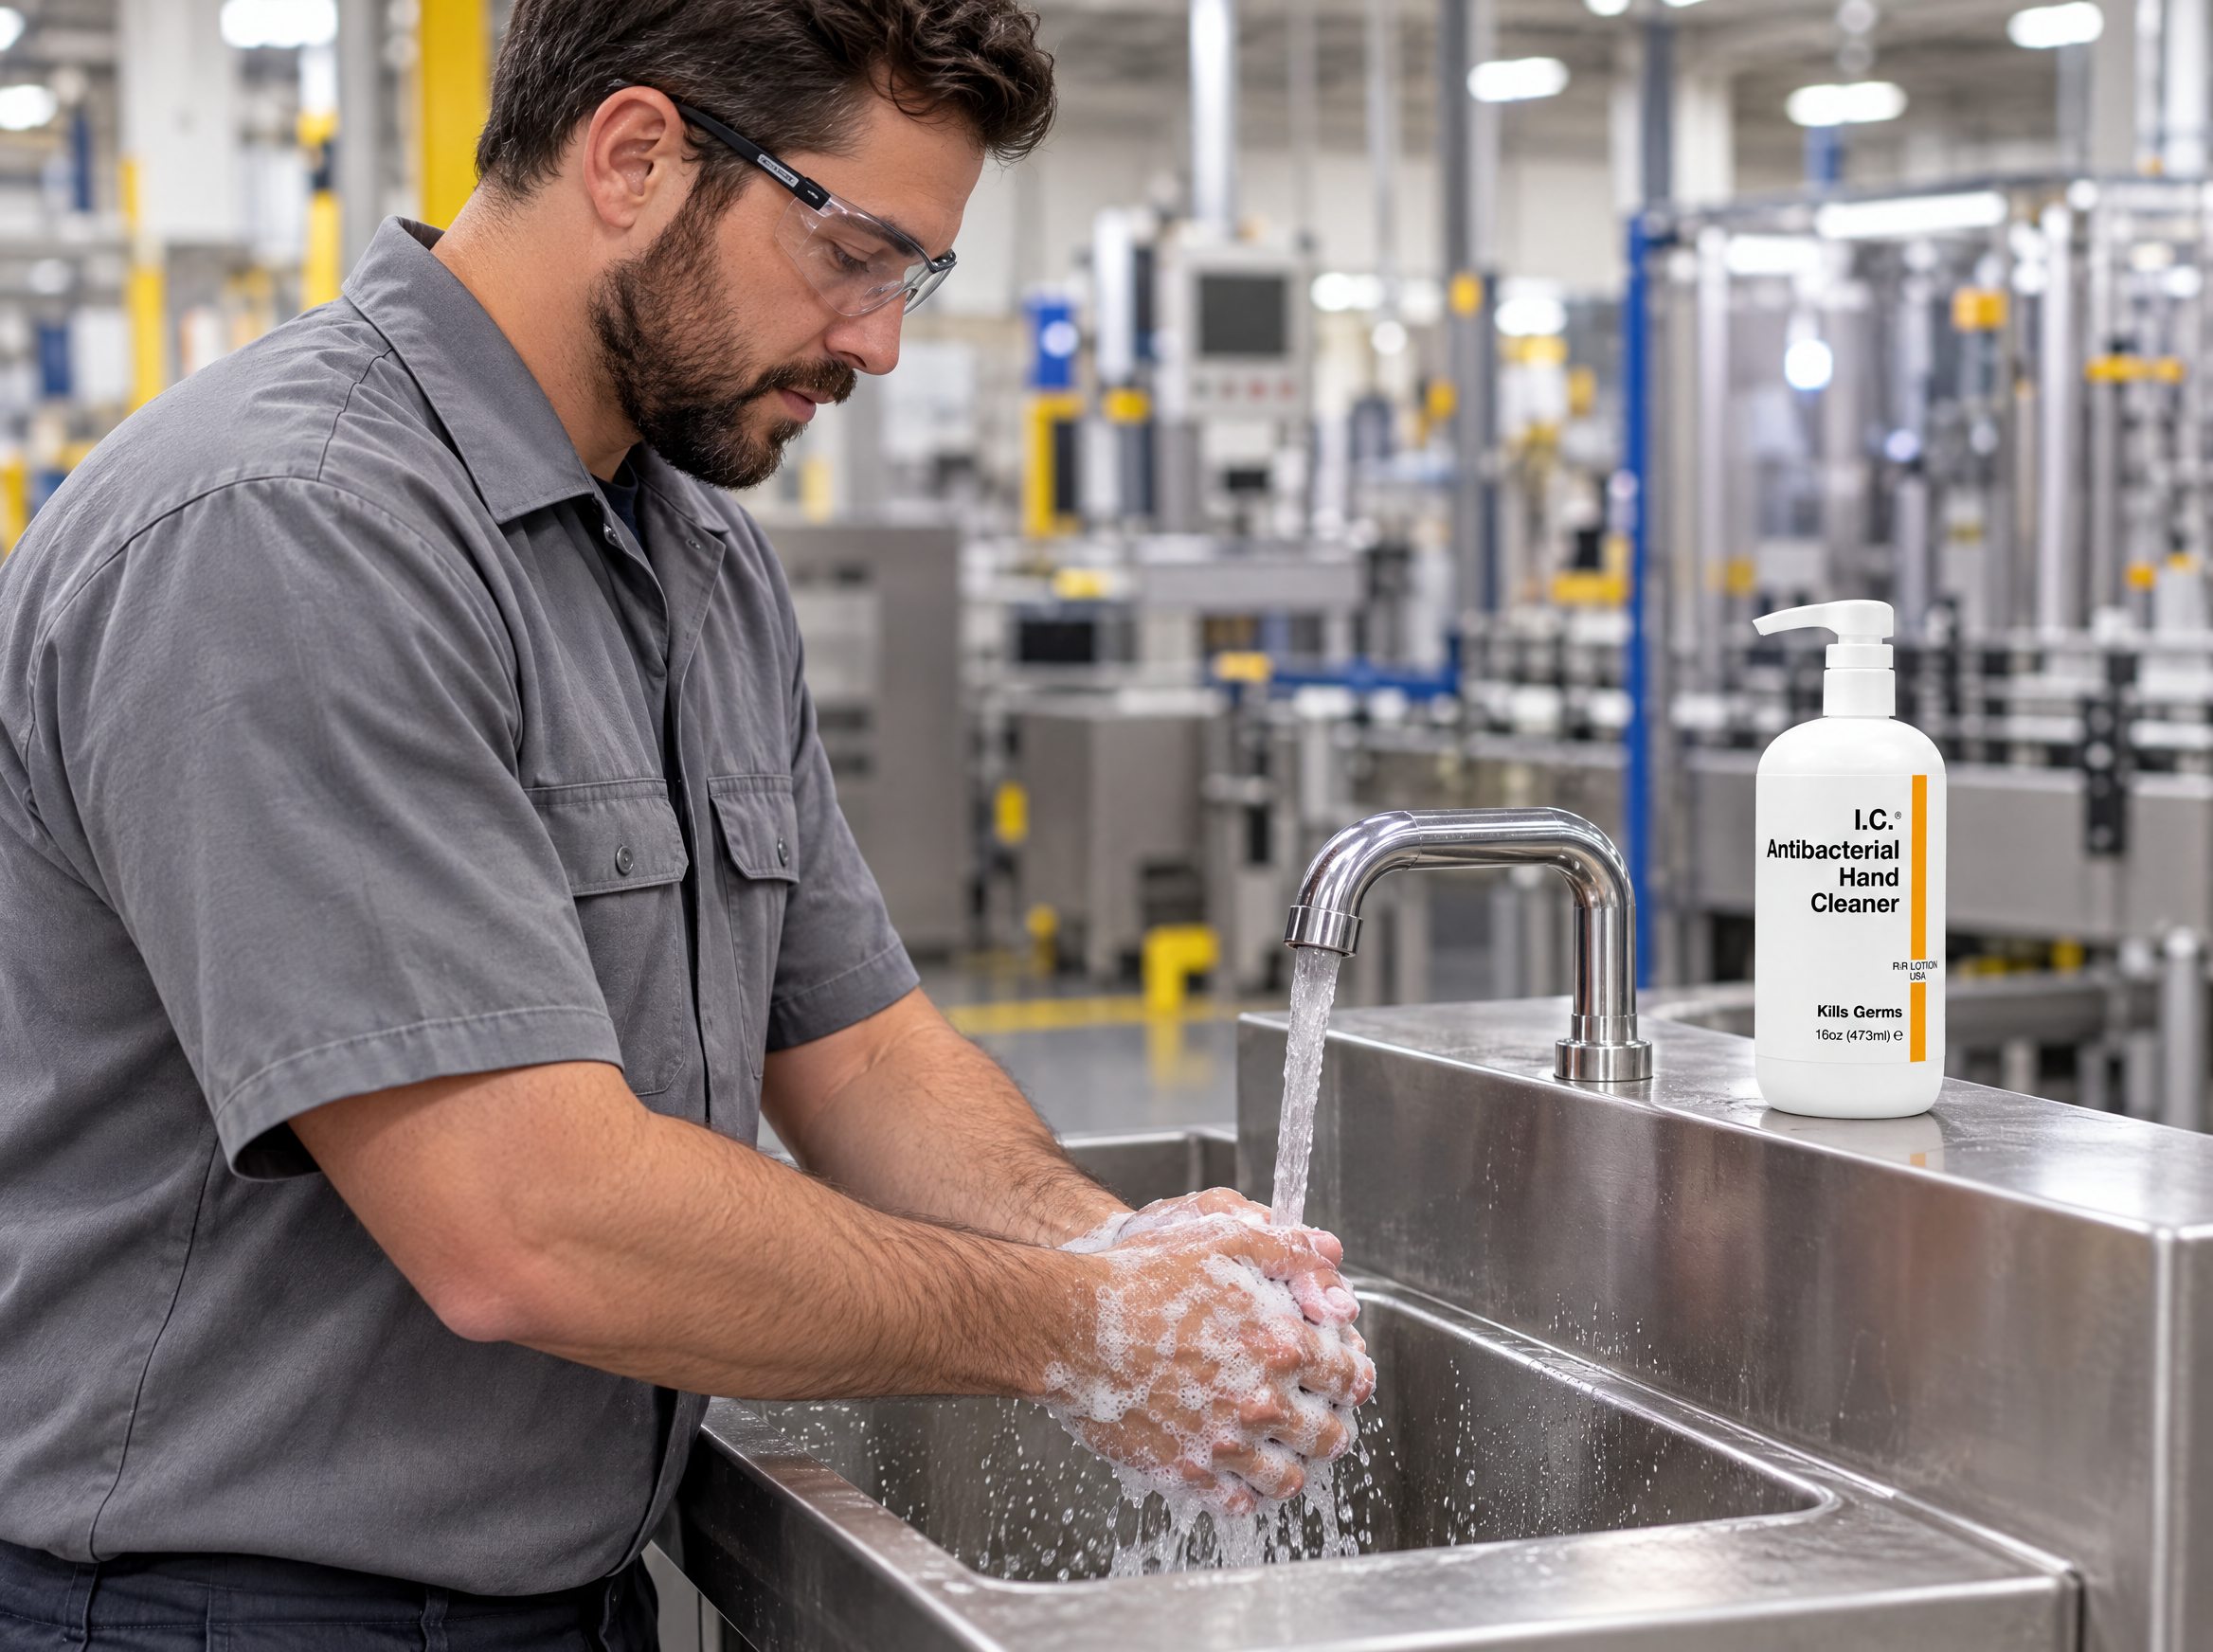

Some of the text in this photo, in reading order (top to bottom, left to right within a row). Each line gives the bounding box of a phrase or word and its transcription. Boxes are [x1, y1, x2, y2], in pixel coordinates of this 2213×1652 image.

[1766, 838, 1899, 860] Antibacterial
[1839, 867, 1899, 888] Hand
[1810, 892, 1900, 913] Cleaner
[1910, 961, 1938, 971] LOTION
[1909, 971, 1927, 981] USA
[1817, 1004, 1903, 1018] Kills Germs
[1815, 1029, 1844, 1041] 16oz
[1846, 1030, 1891, 1044] (473ml)
